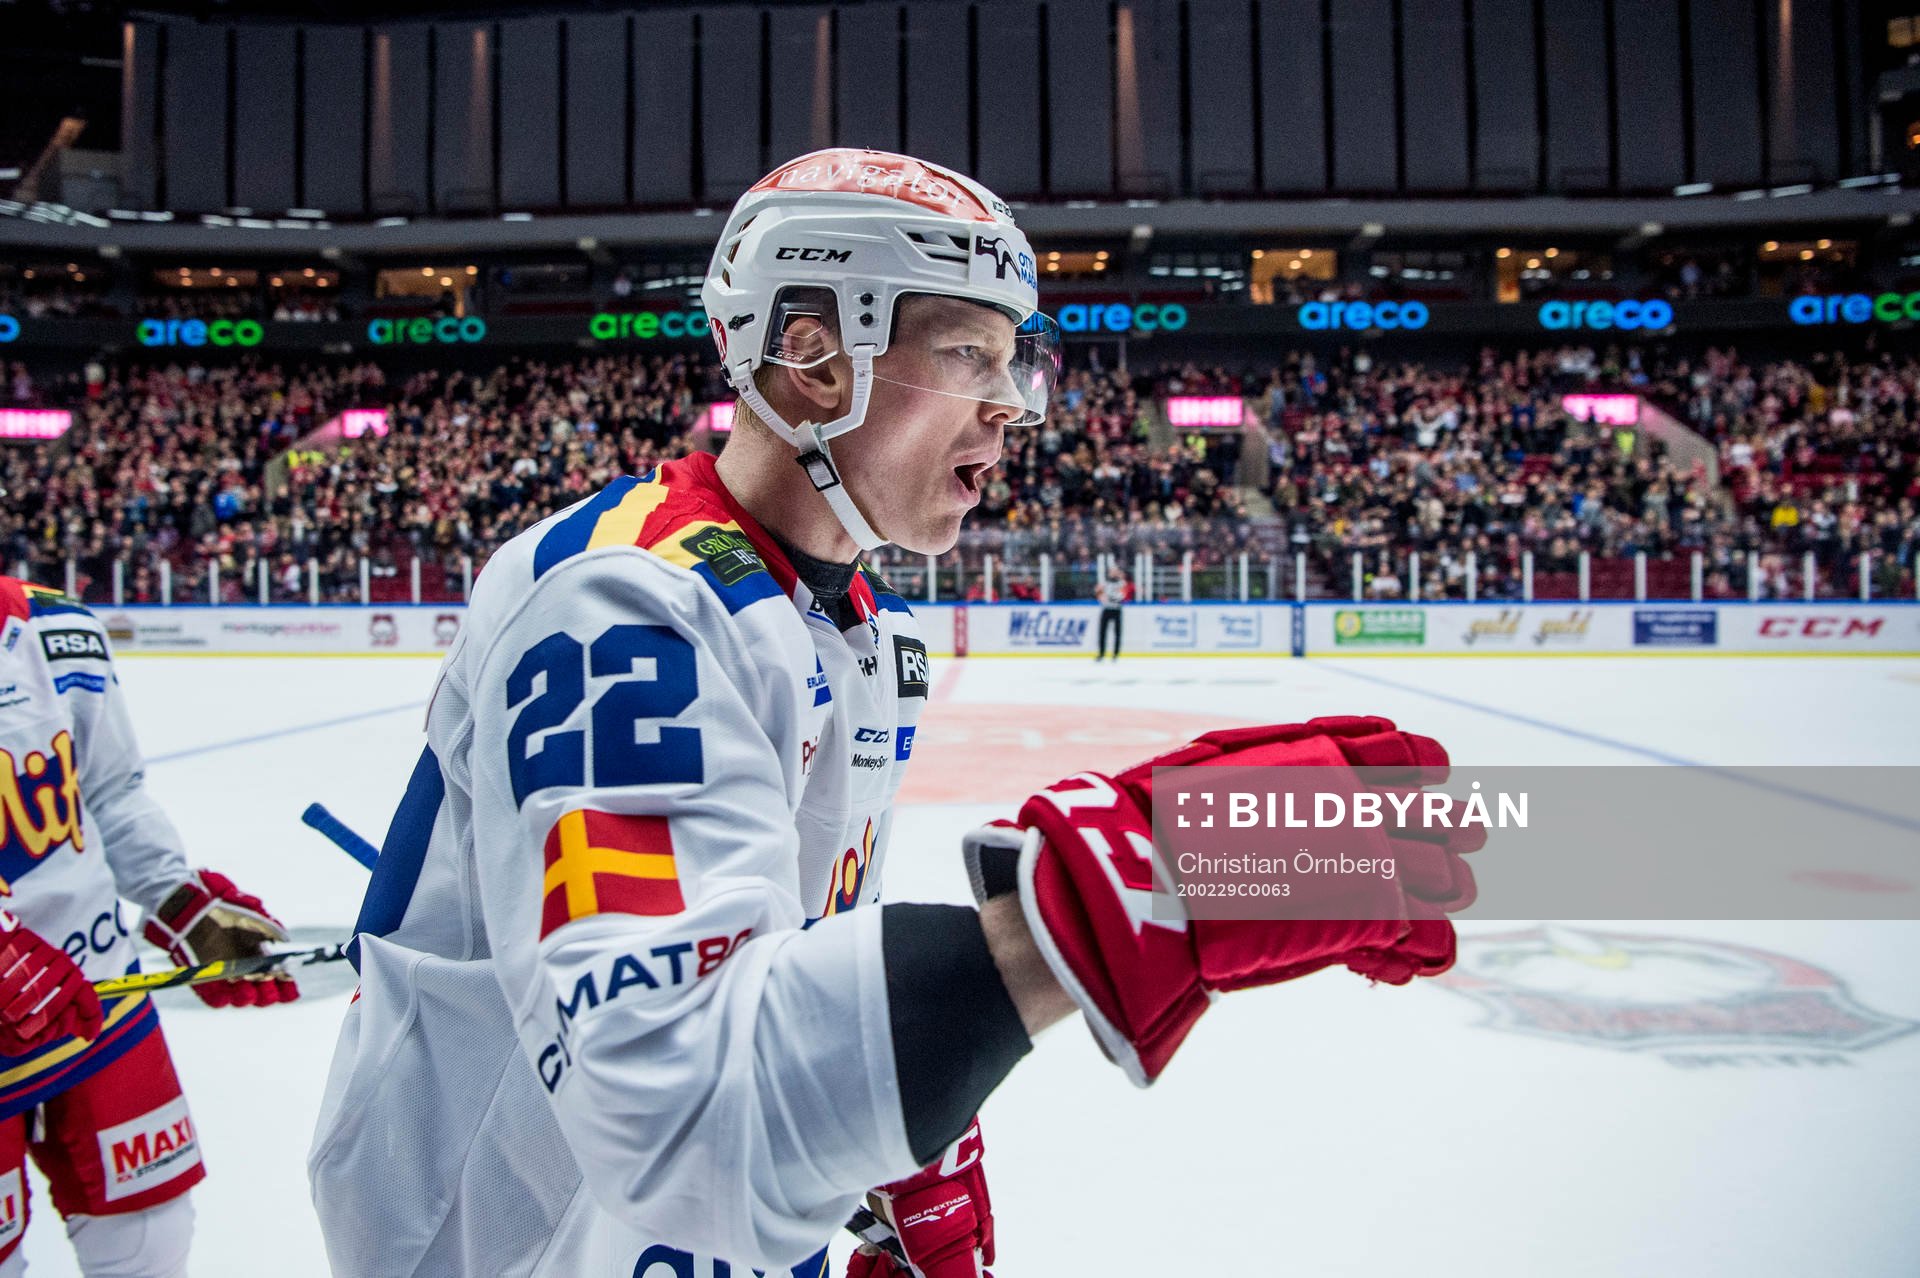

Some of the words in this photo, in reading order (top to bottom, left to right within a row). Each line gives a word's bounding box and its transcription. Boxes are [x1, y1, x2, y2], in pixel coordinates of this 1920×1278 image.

[777, 155, 967, 208] navigator
[775, 246, 853, 264] CCM
[1058, 303, 1189, 332] areco
[1297, 300, 1430, 331] areco
[1539, 299, 1674, 330] areco
[1789, 293, 1920, 324] areco
[137, 318, 263, 346] areco
[368, 316, 487, 343] areco
[590, 311, 711, 339] areco
[1758, 616, 1886, 638] CCM
[45, 633, 105, 655] RSA
[901, 650, 928, 684] RS
[506, 624, 704, 814] 22
[112, 1116, 193, 1175] MAXI
[902, 1213, 922, 1225] PRO
[923, 1193, 970, 1216] FLEXTHUMB
